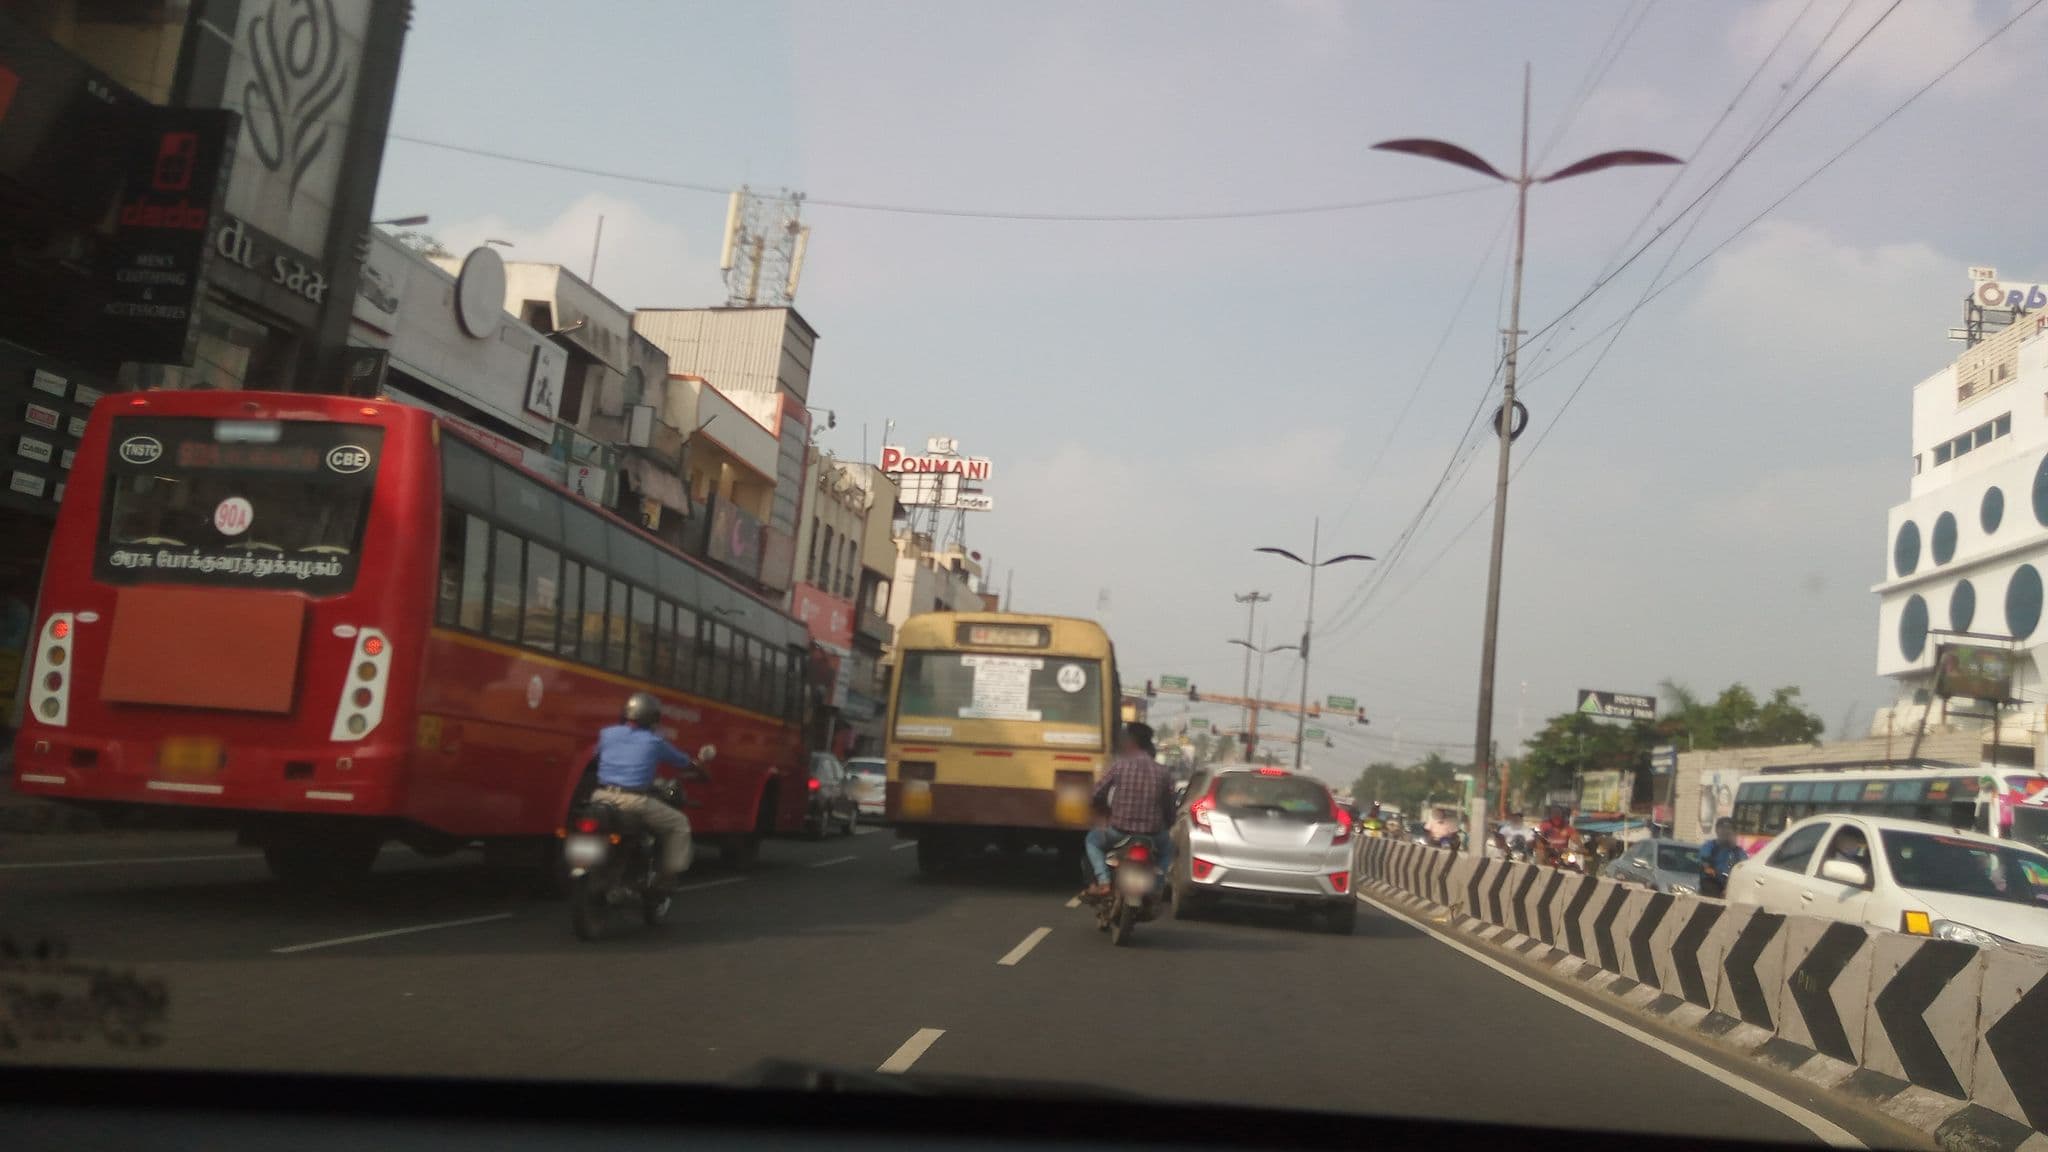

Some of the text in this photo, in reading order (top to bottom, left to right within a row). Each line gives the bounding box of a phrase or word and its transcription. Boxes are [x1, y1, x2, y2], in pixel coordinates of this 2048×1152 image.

[272, 255, 328, 304] saa
[126, 443, 160, 457] TNSTC
[331, 452, 366, 467] CBE
[218, 503, 246, 528] 90A
[1614, 695, 1650, 707] HOTEL
